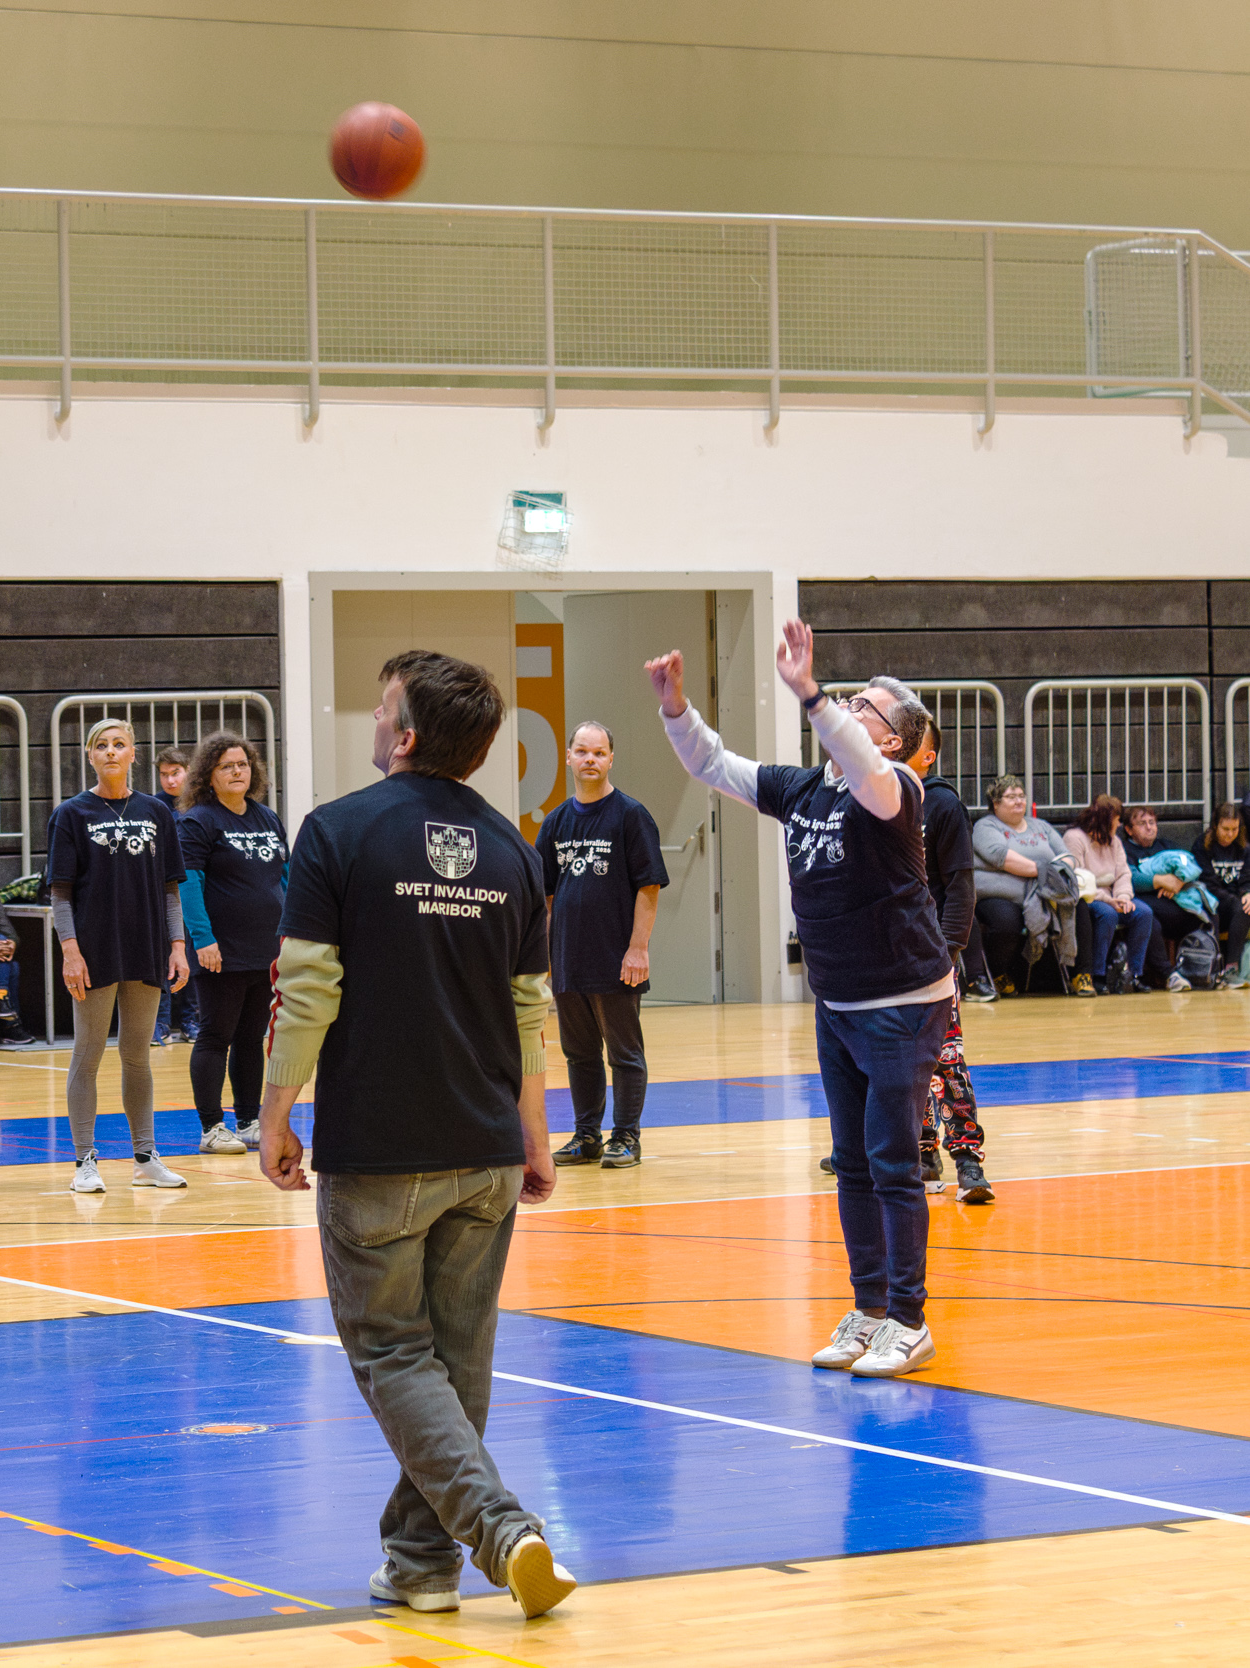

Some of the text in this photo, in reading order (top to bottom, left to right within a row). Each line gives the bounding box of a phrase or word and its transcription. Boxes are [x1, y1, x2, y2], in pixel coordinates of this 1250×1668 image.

[87, 823, 116, 833] Športne
[583, 839, 613, 847] invalidov
[395, 882, 508, 905] SVET INVALIDOV
[417, 901, 482, 919] MARIBOR
